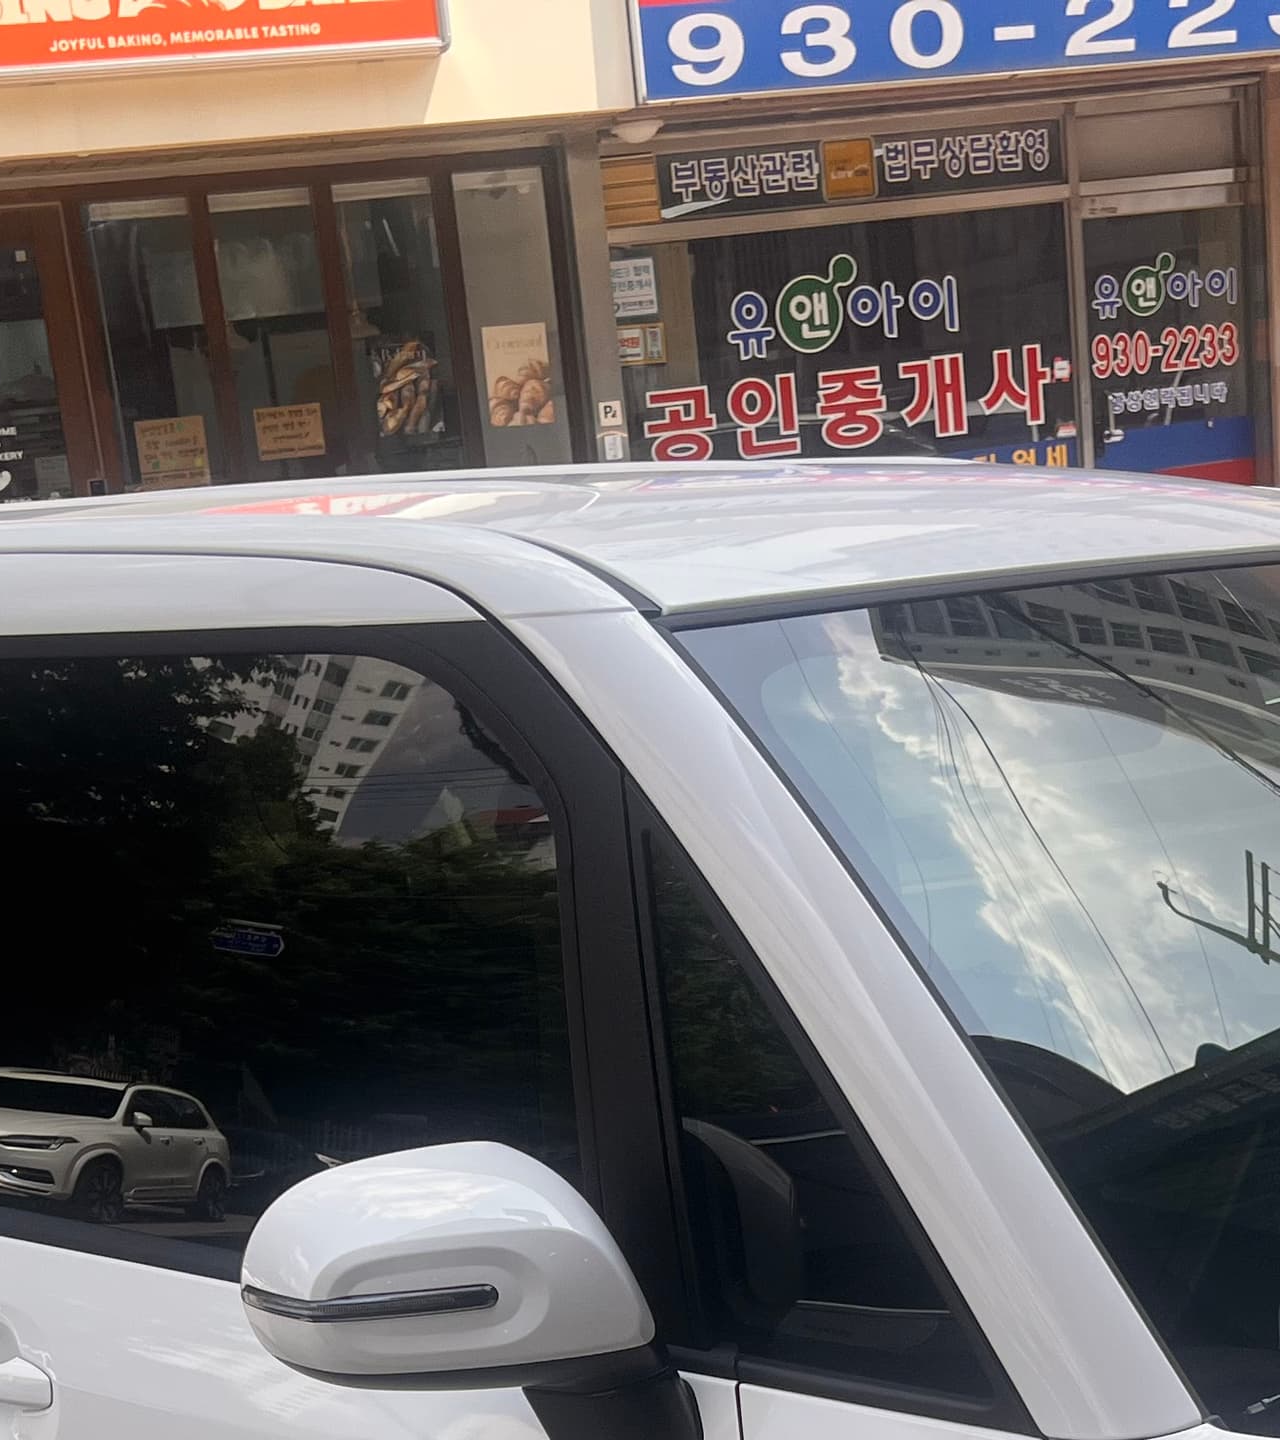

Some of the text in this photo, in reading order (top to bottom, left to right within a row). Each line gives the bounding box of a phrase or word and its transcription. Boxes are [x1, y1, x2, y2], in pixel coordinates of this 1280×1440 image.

[49, 22, 321, 52] JOYFUL BAKING, MEMORABLE TASTING
[670, 128, 1050, 202] 부동산관련 법무상담환영
[727, 272, 961, 361] 유앤아이
[1092, 264, 1238, 320] 유앤아이
[1091, 322, 1240, 379] 930-2233
[644, 343, 1052, 462] 공인중개사
